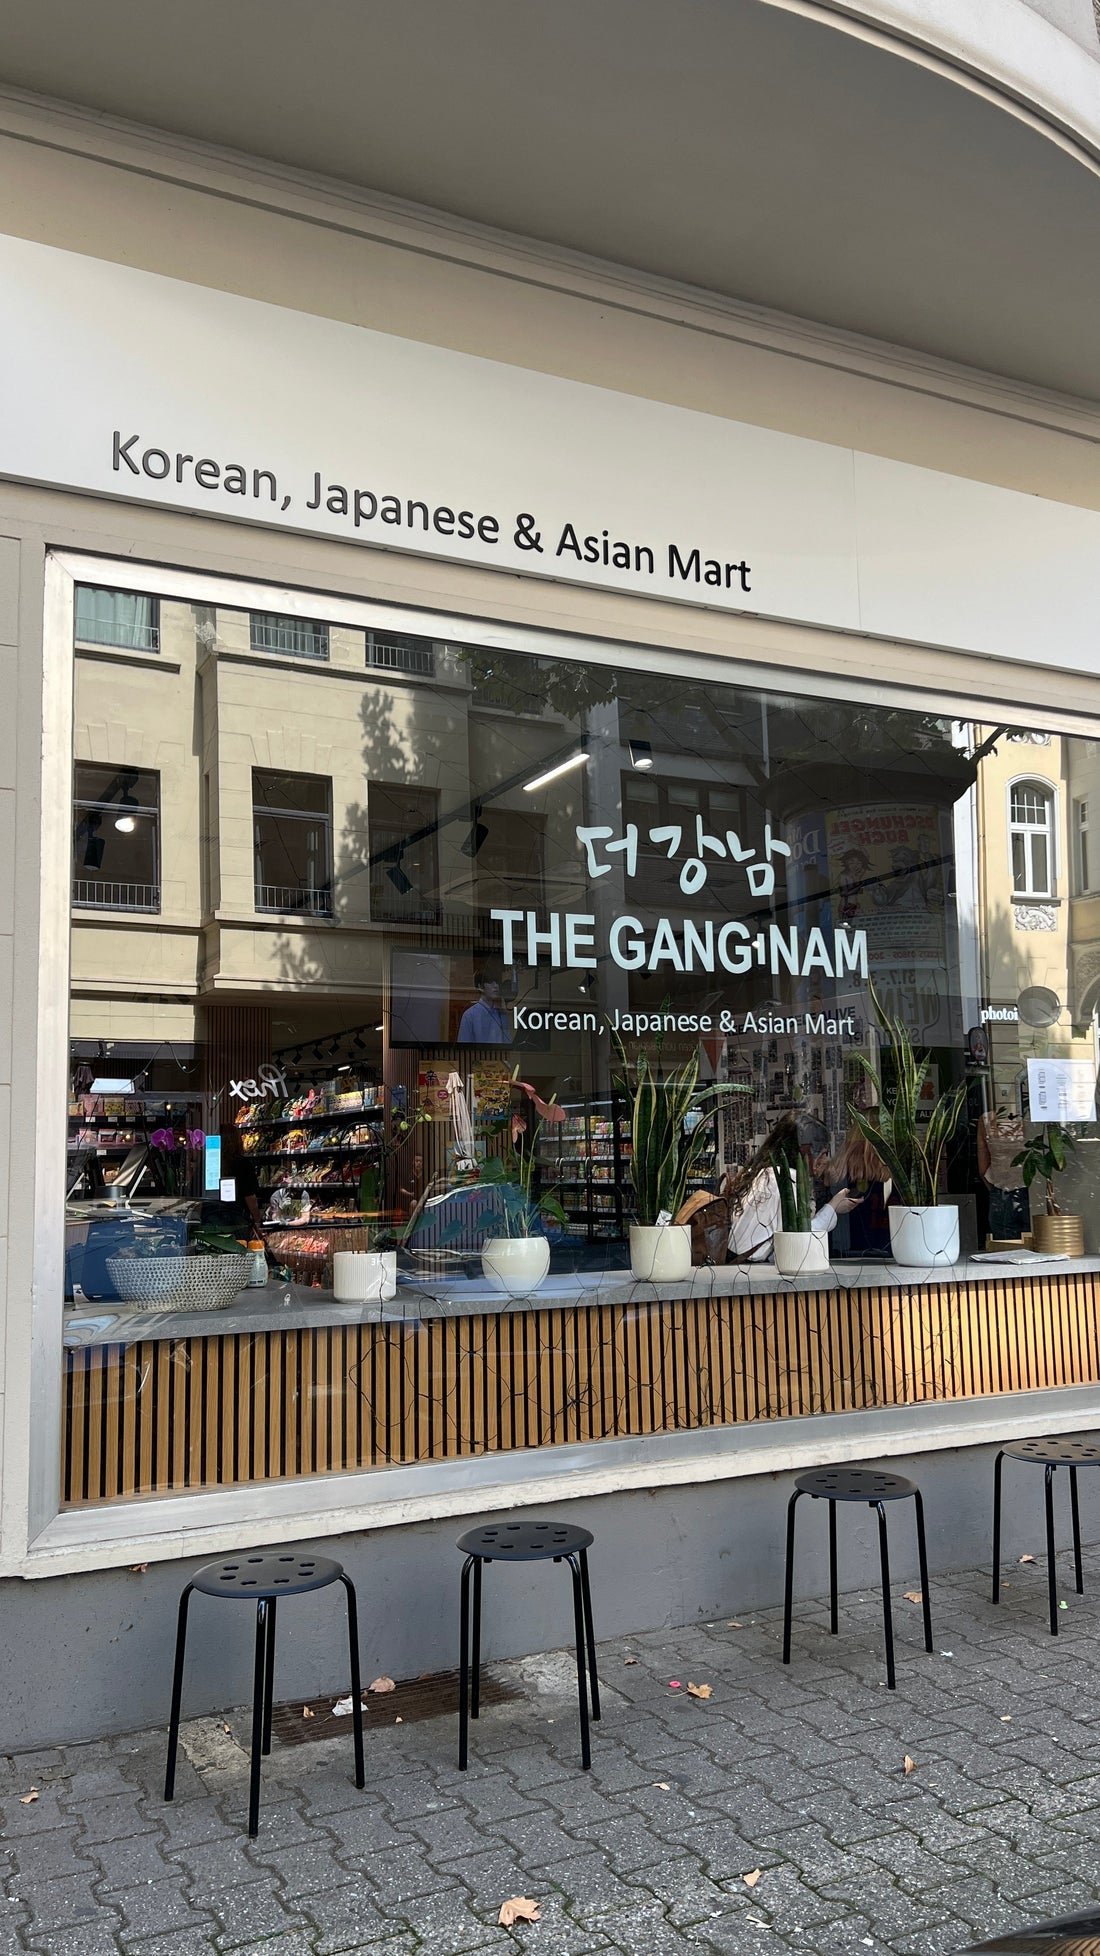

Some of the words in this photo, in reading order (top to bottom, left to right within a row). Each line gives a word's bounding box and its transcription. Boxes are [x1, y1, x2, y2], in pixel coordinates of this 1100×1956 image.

[113, 431, 291, 511] Korean,
[306, 472, 500, 544] Japanese
[513, 513, 544, 554] &
[556, 523, 654, 574] Asian
[668, 544, 752, 593] Mart
[575, 813, 792, 897] 더강남
[490, 908, 597, 969] THE
[513, 1006, 604, 1036] Korean,
[611, 1008, 712, 1037] Japanese
[719, 1009, 737, 1033] &
[742, 1011, 798, 1034] Asian
[805, 1013, 855, 1036] Mart
